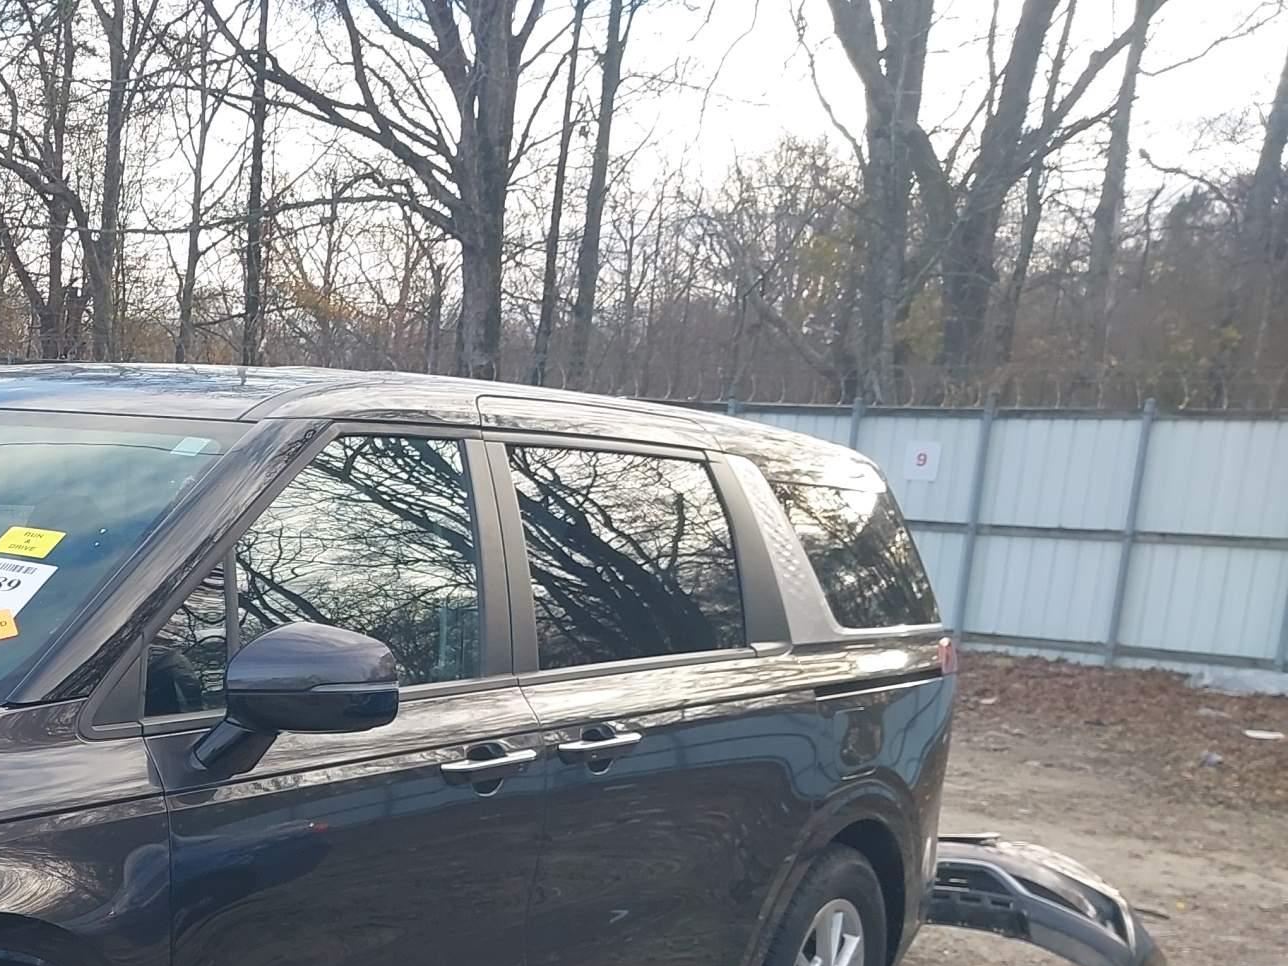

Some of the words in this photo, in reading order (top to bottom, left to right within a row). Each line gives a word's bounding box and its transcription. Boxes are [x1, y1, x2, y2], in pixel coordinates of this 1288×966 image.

[916, 452, 928, 467] 9
[23, 531, 45, 539] RUN
[7, 543, 38, 552] DRIVE
